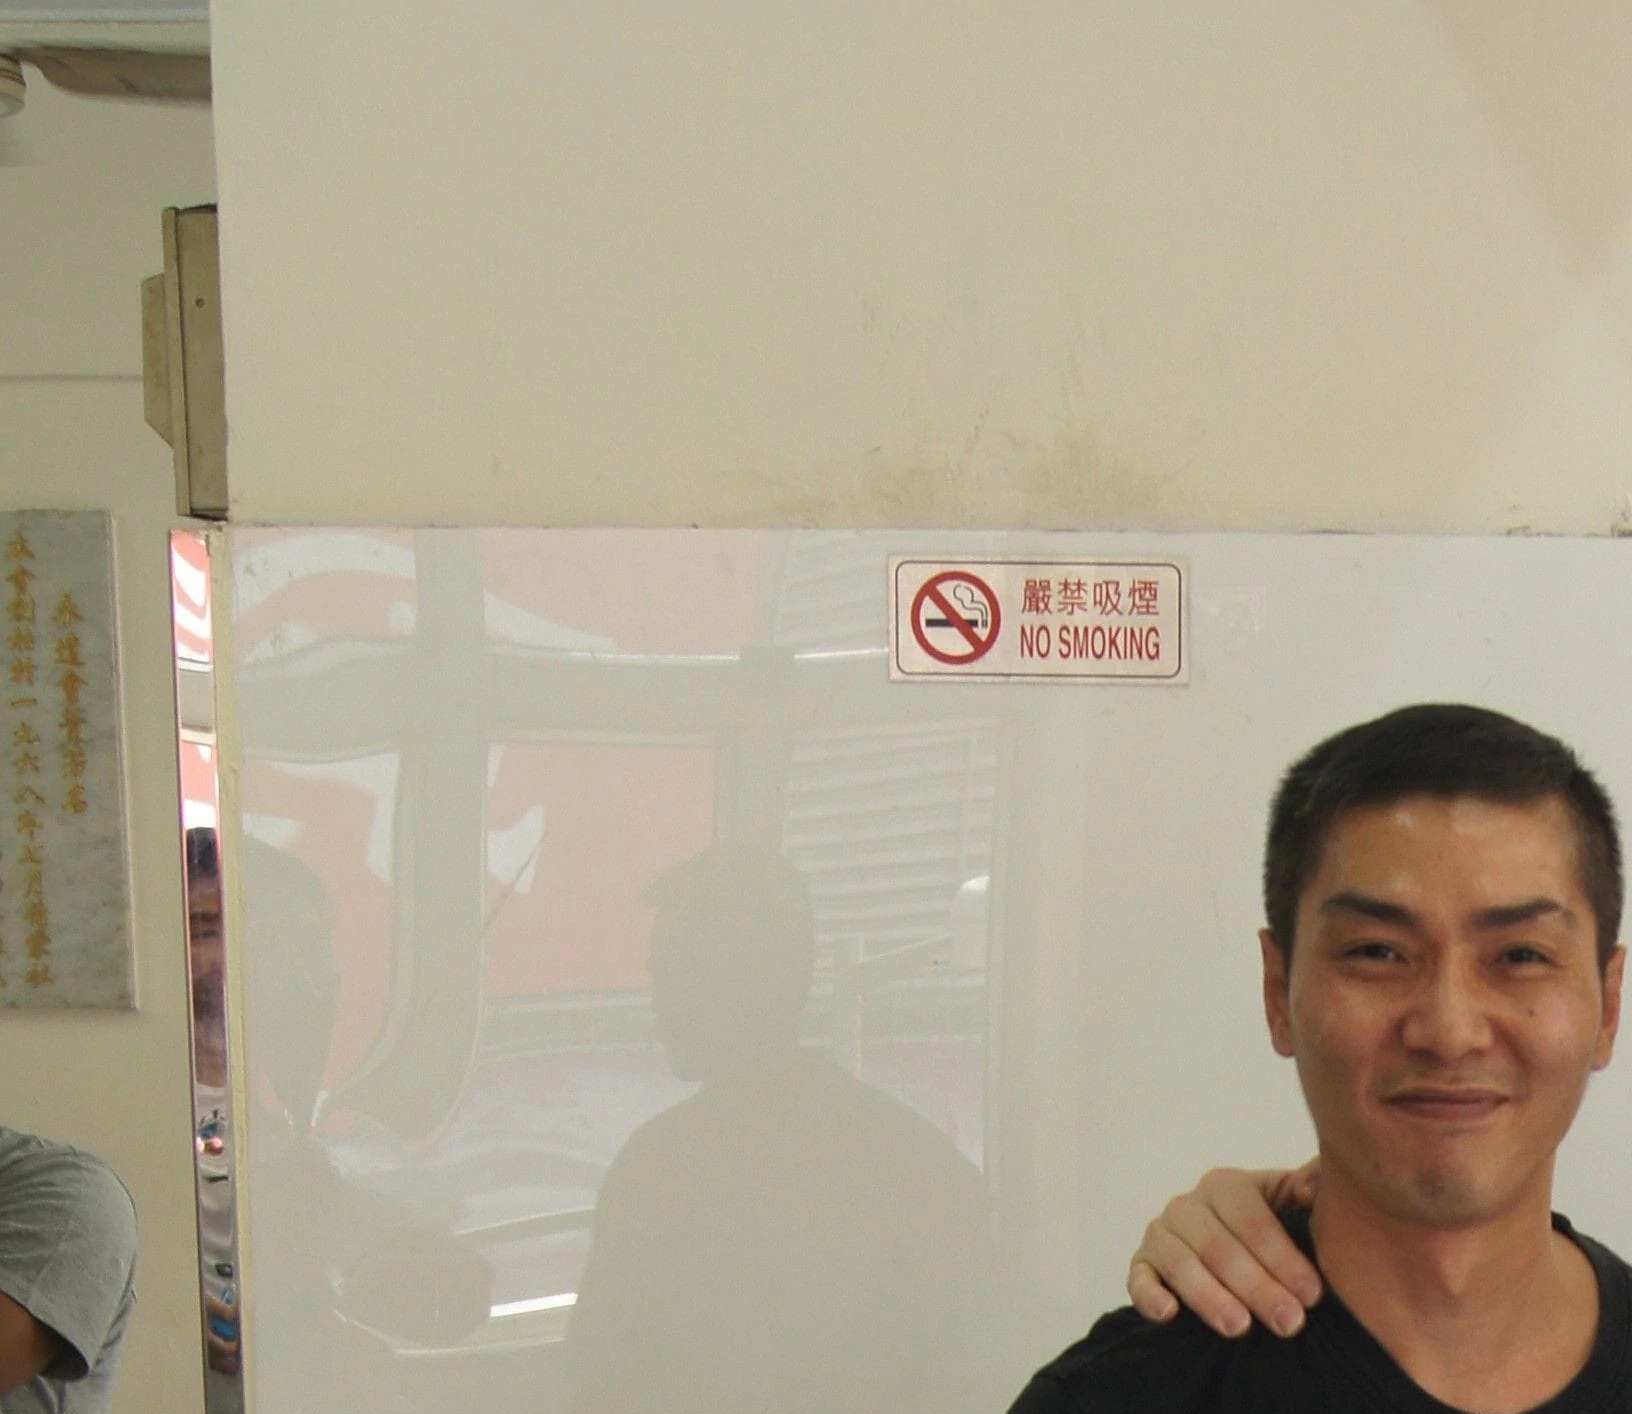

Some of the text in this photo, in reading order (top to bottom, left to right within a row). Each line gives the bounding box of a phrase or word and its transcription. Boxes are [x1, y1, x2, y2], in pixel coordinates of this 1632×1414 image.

[1021, 577, 1160, 616] 嚴禁吸煙
[1020, 624, 1160, 661] NO SMOKING
